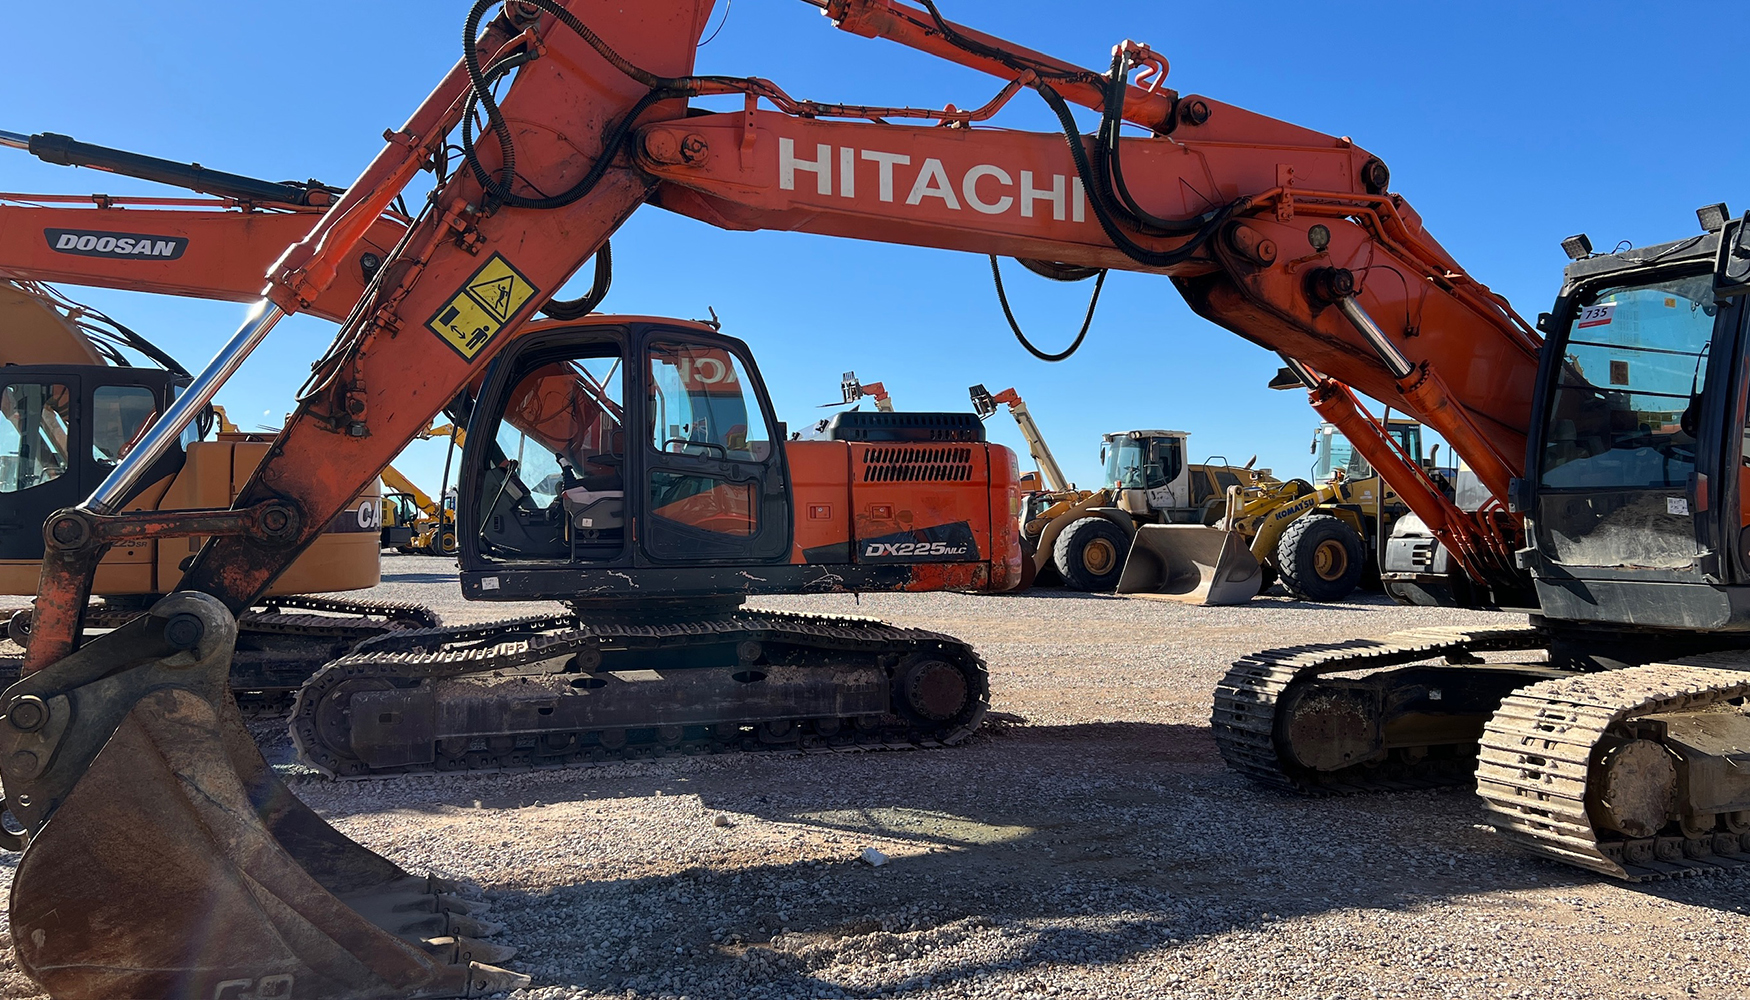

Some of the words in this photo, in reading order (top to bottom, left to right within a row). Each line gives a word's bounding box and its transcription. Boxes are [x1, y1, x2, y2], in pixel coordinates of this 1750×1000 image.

[778, 137, 1086, 223] HITACHI
[56, 233, 177, 257] DOOSAN
[1585, 306, 1608, 320] 735
[357, 501, 382, 528] CA
[1275, 497, 1315, 520] KOMATSU
